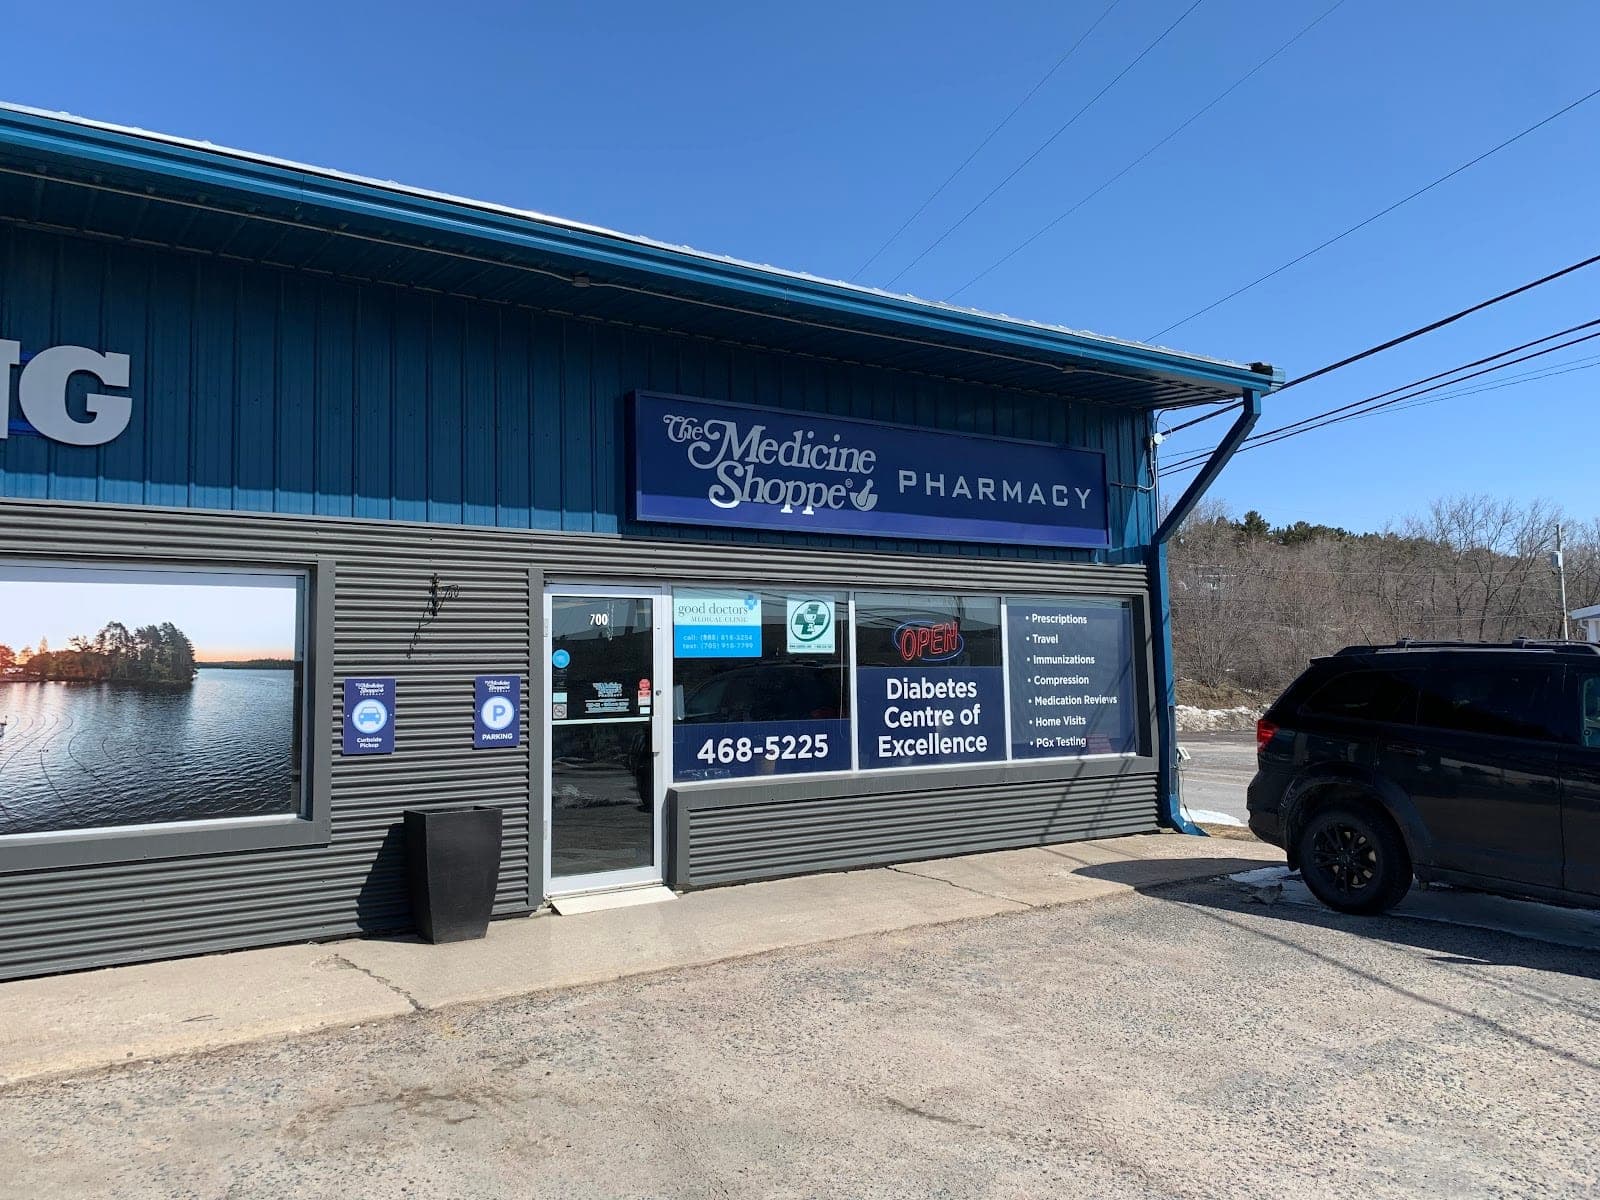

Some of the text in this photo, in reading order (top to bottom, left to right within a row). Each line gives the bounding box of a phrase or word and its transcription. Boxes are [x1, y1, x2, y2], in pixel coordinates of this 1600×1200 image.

[663, 414, 876, 474] The Medicine
[709, 460, 847, 515] Shoppe
[898, 469, 1091, 510] PHARMACY
[678, 602, 748, 617] good doctors
[589, 613, 608, 626] 700
[1031, 613, 1088, 625] Prescriptions
[901, 621, 958, 663] OPEN
[1032, 633, 1059, 644] Travel
[1033, 654, 1096, 665] Immunizations
[1034, 674, 1090, 686] Compression
[886, 677, 978, 700] Diabetes
[1034, 694, 1118, 706] Medication Reviews
[492, 704, 506, 722] P
[884, 704, 981, 728] Centre of
[1035, 715, 1087, 727] Home Visits
[481, 732, 513, 741] PARKING
[1036, 736, 1087, 748] PGx Testing
[697, 734, 829, 764] 468-5225
[878, 733, 988, 758] Excellence
